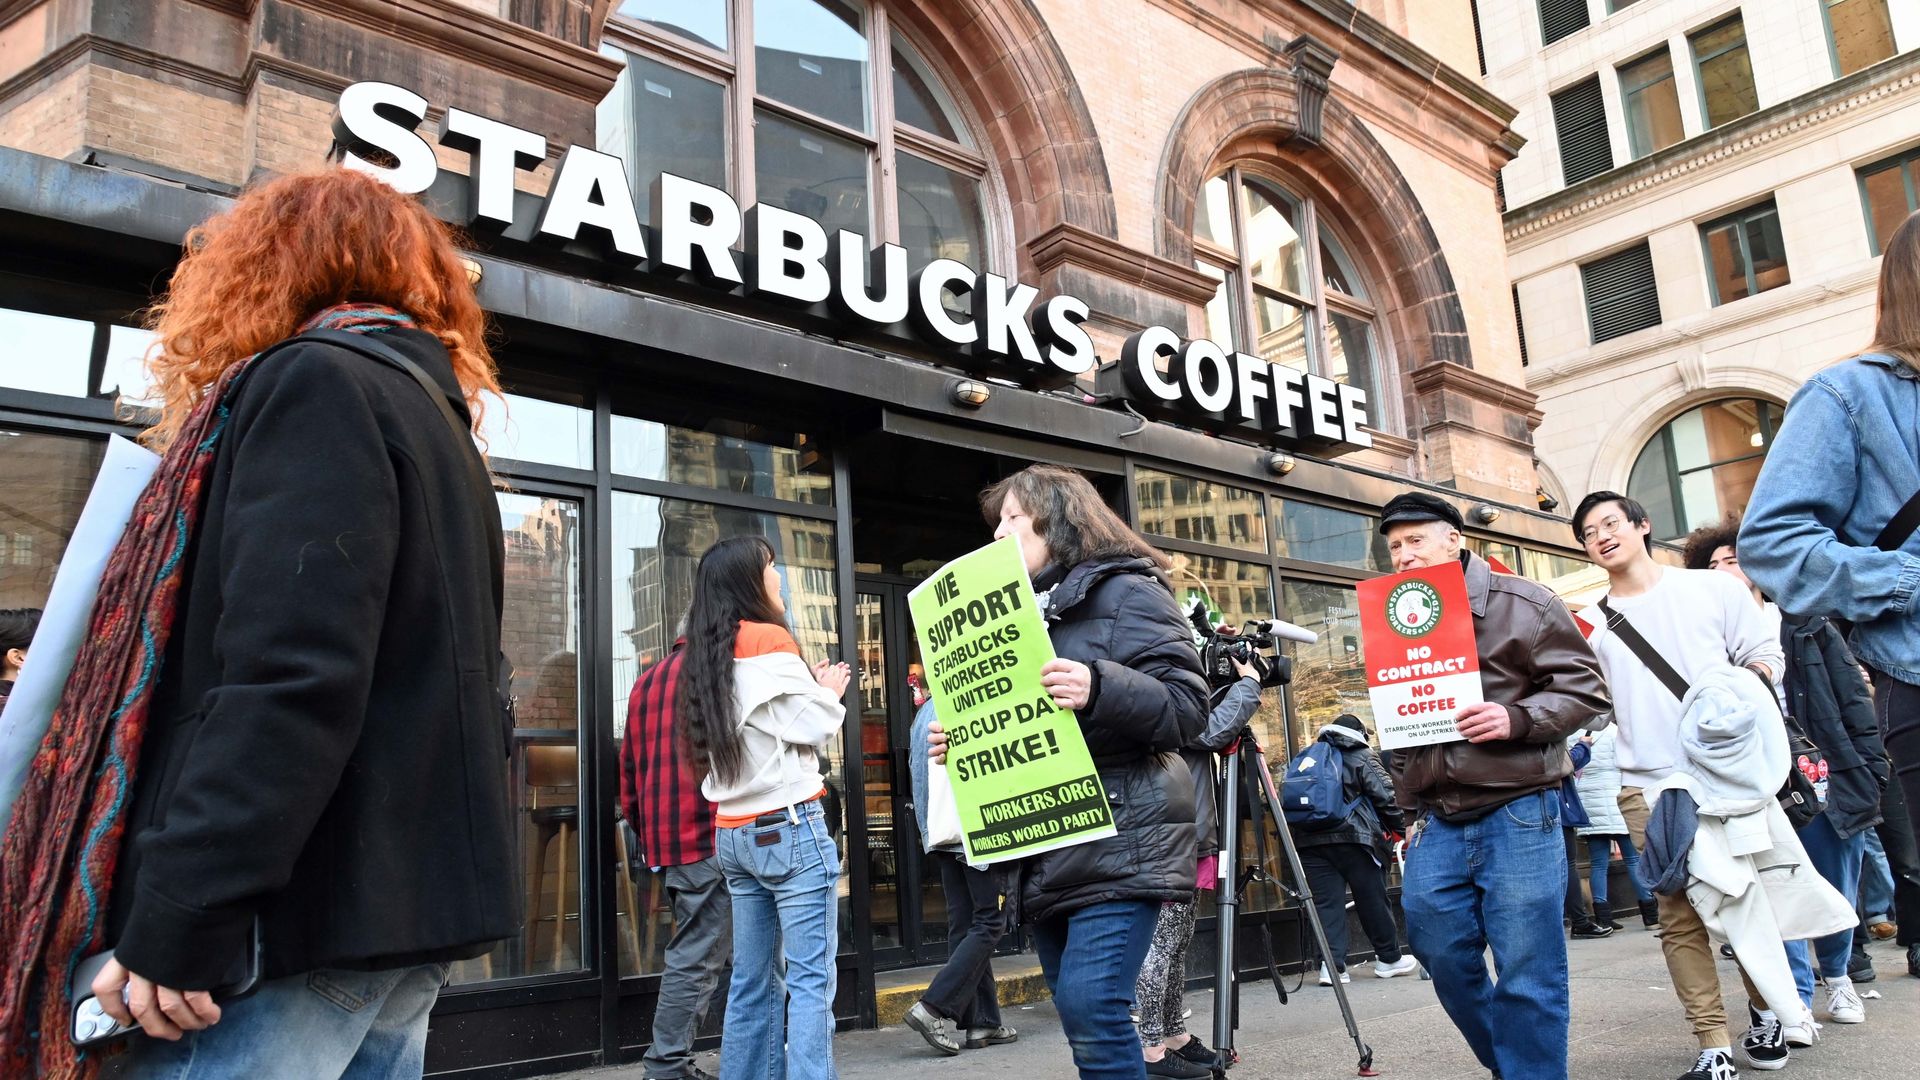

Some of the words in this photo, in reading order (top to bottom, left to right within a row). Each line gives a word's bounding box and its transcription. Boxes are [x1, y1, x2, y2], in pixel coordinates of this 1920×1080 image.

[339, 80, 1096, 374] STARBUCKS
[1137, 325, 1373, 448] COFFEE
[933, 571, 961, 608] WE
[1390, 582, 1434, 603] STARBUCKS
[927, 580, 1023, 654] SUPPORT
[1388, 607, 1418, 636] WORKERS
[1422, 600, 1440, 632] UNITED
[933, 623, 1021, 678] STARBUCKS
[1377, 656, 1467, 682] CONTRACT
[1406, 645, 1432, 661] NO
[941, 649, 1019, 696] WORKERS
[1411, 683, 1436, 698] NO
[952, 676, 1013, 713] UNITED
[1397, 697, 1457, 717] COFFEE
[944, 725, 969, 749] RED
[970, 709, 1012, 739] CUP
[1384, 723, 1420, 734] STARBUCKS
[1421, 719, 1453, 729] WORKERS
[1431, 727, 1456, 736] STRIKE!
[956, 728, 1061, 782] STRIKE!
[982, 779, 1098, 825] WORKERS.ORG
[972, 832, 1011, 852] WORKERS
[1012, 819, 1060, 843] WORLD
[1063, 807, 1104, 831] PARTY
